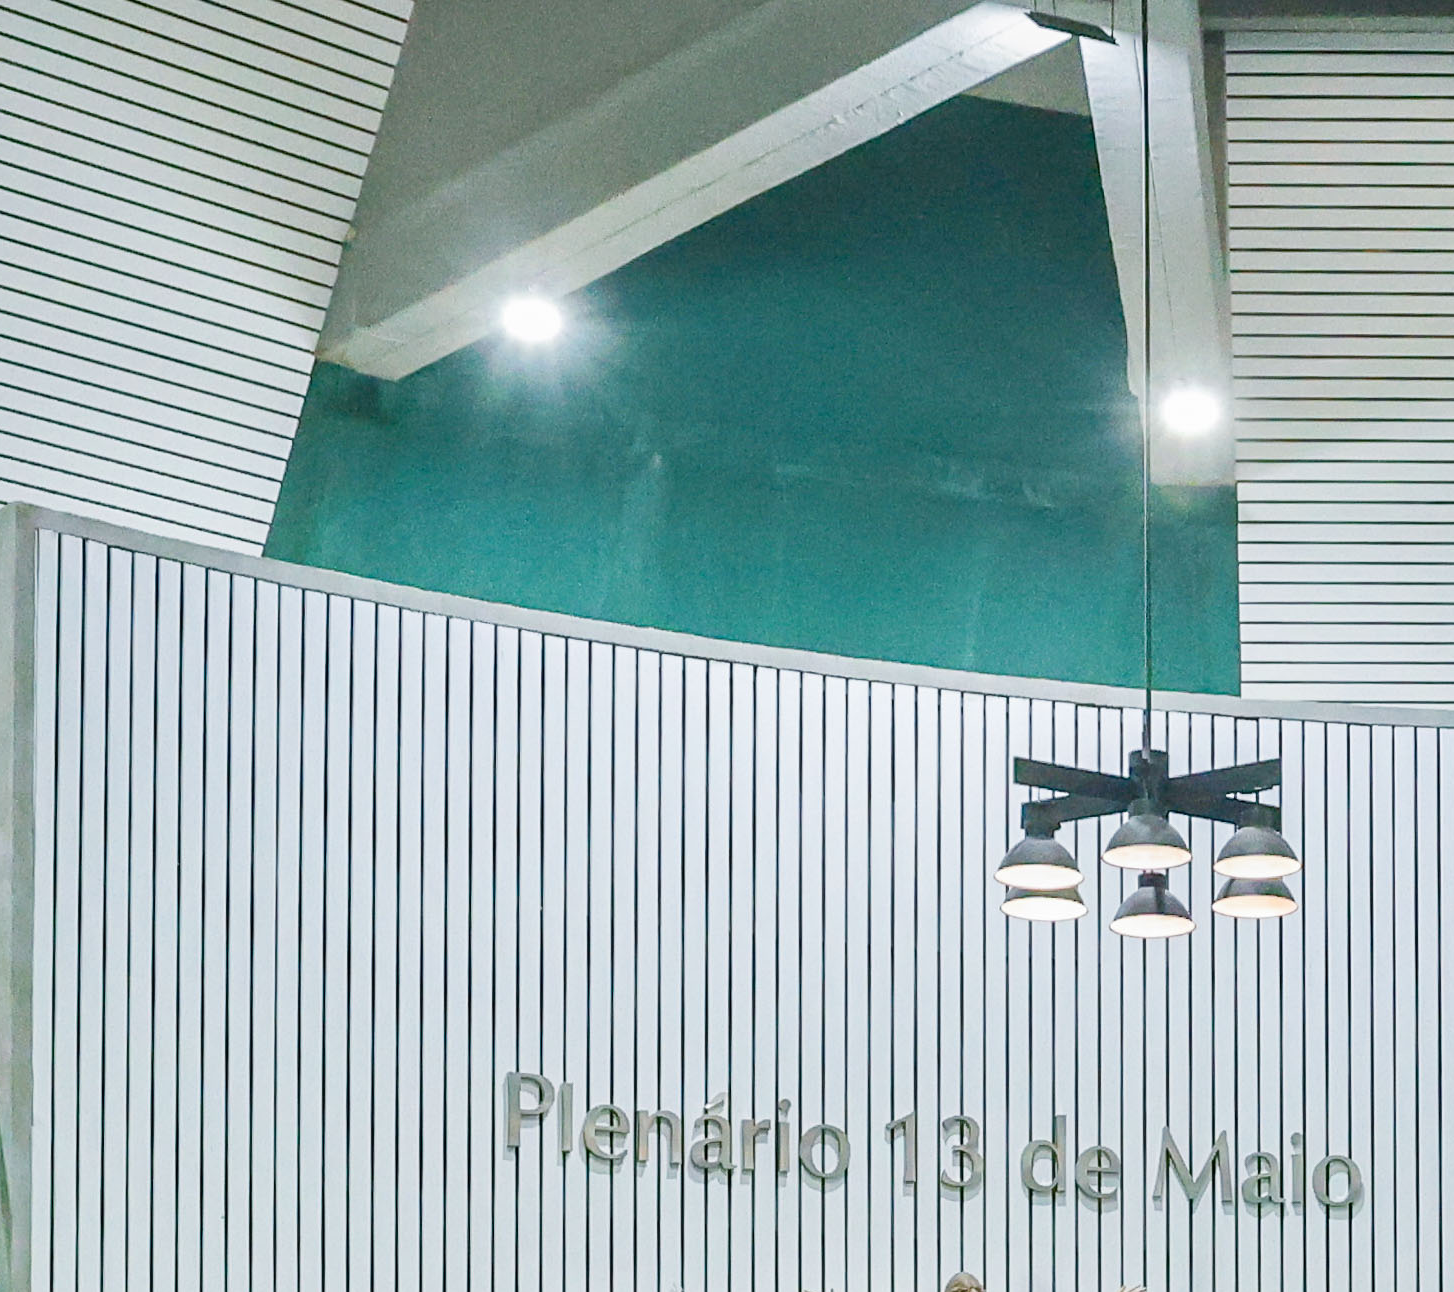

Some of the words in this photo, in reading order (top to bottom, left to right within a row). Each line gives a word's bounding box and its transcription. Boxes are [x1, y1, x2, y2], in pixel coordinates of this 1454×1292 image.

[503, 1070, 851, 1182] Plenário
[886, 1109, 985, 1192] 13
[1020, 1114, 1123, 1198] de
[1152, 1124, 1365, 1207] Maio
